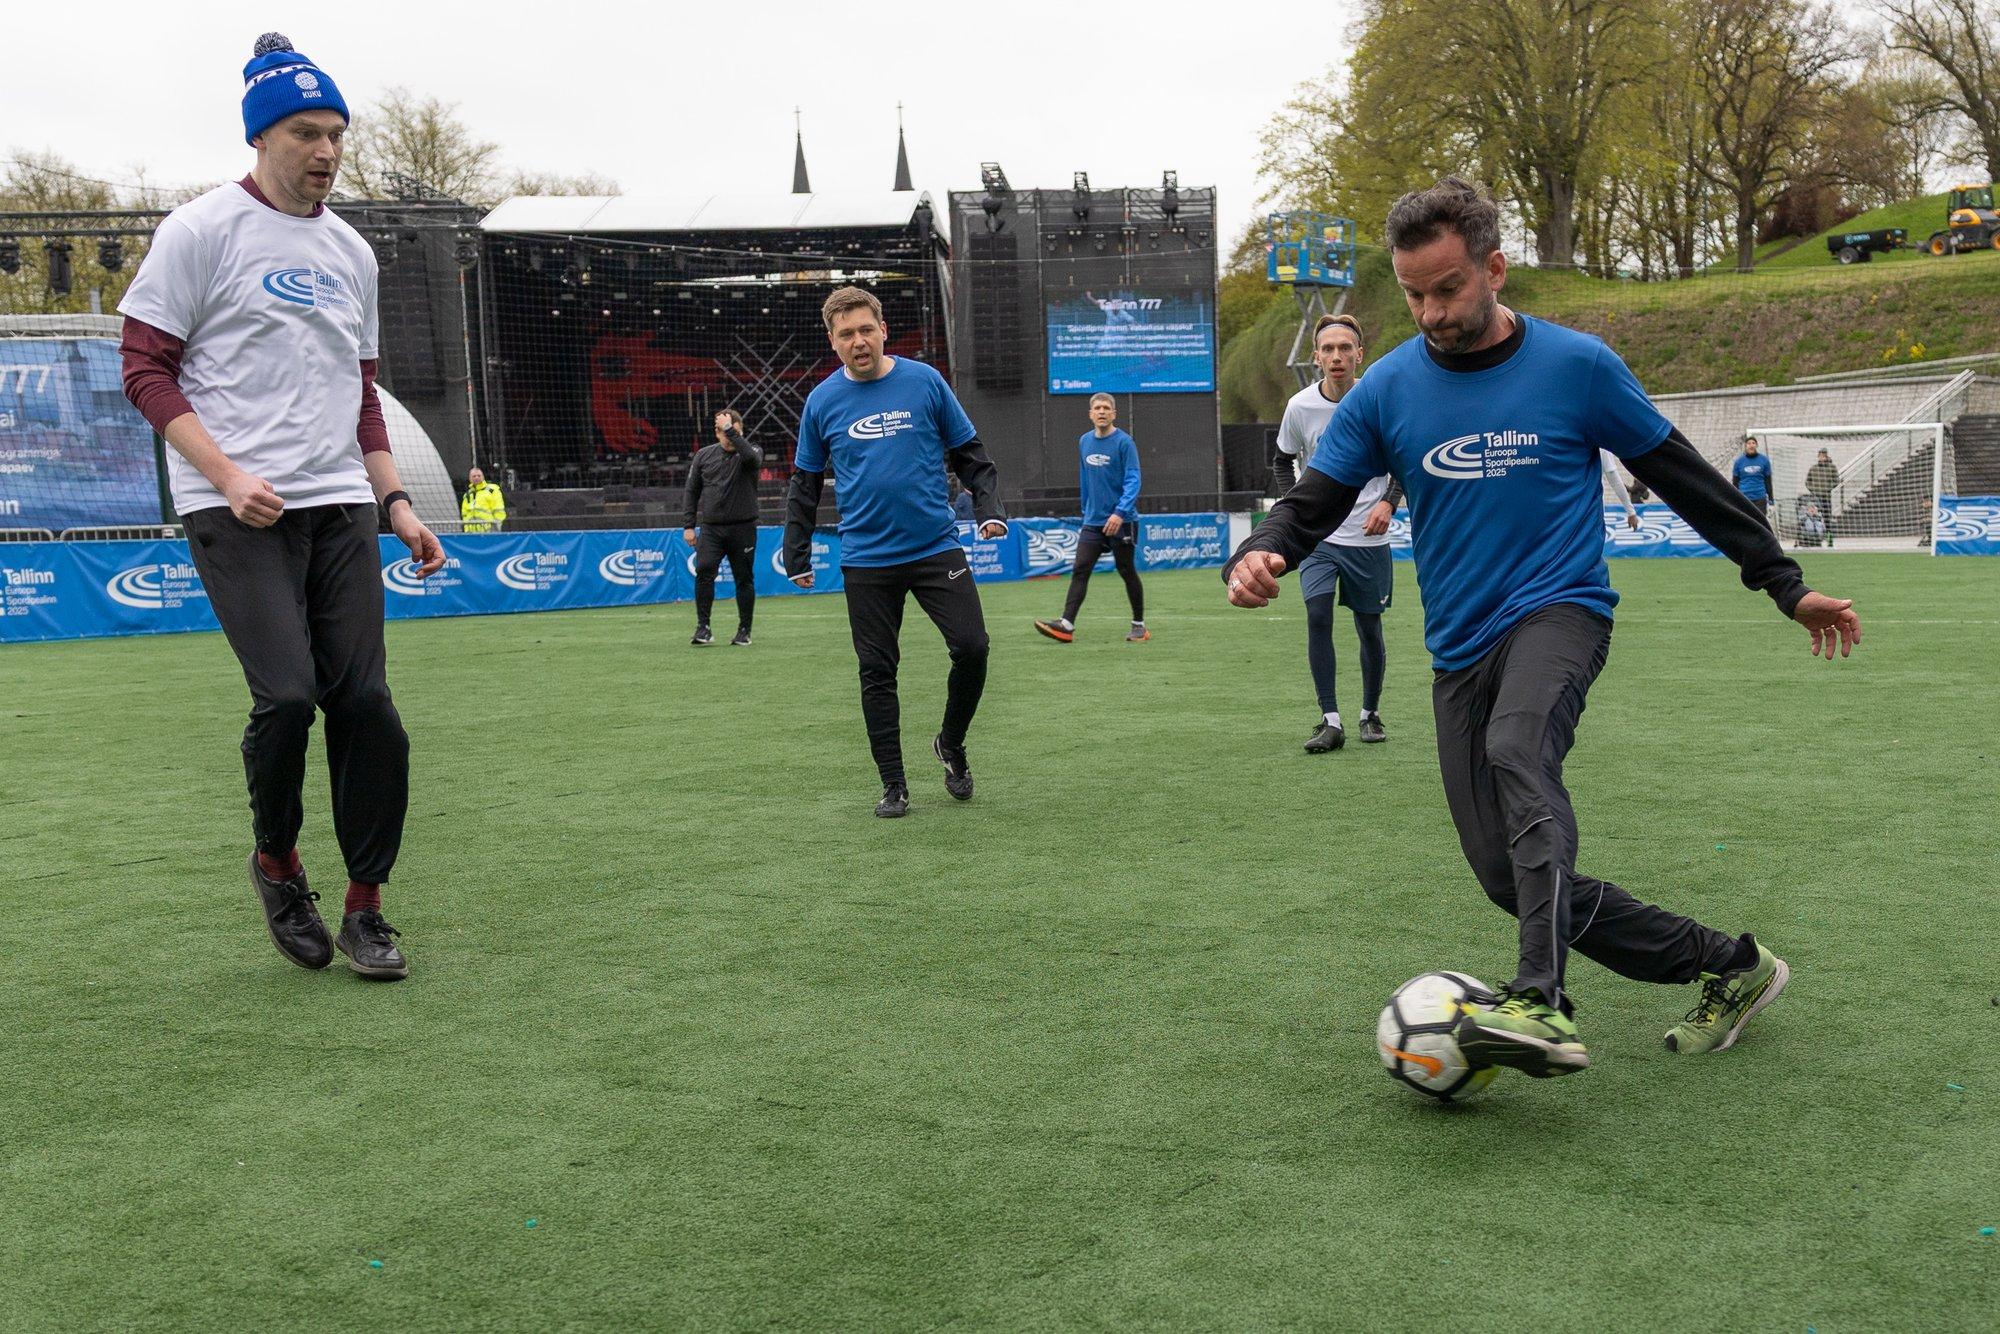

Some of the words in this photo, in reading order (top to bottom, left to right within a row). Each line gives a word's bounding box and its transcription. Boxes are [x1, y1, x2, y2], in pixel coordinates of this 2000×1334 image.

[302, 90, 321, 98] KUKU
[313, 270, 344, 289] Tallin
[1097, 299, 1137, 310] Tallinn
[1139, 298, 1162, 310] 777
[1062, 380, 1091, 389] Tallinn
[881, 410, 911, 421] Tallinn
[1483, 430, 1538, 448] Tallinn
[1484, 448, 1517, 458] Euroopa
[1485, 456, 1539, 468] Spordipealinn
[1486, 468, 1507, 478] 2025
[1145, 524, 1172, 541] Tallinn
[1173, 527, 1185, 540] on
[1185, 523, 1218, 541] Euroopa
[534, 552, 568, 565] Tallinn
[3, 568, 55, 585] Tallinn
[160, 563, 199, 579] Tallin
[5, 586, 36, 595] Euroopa
[164, 599, 183, 608] 2025
[7, 606, 29, 616] 2025
